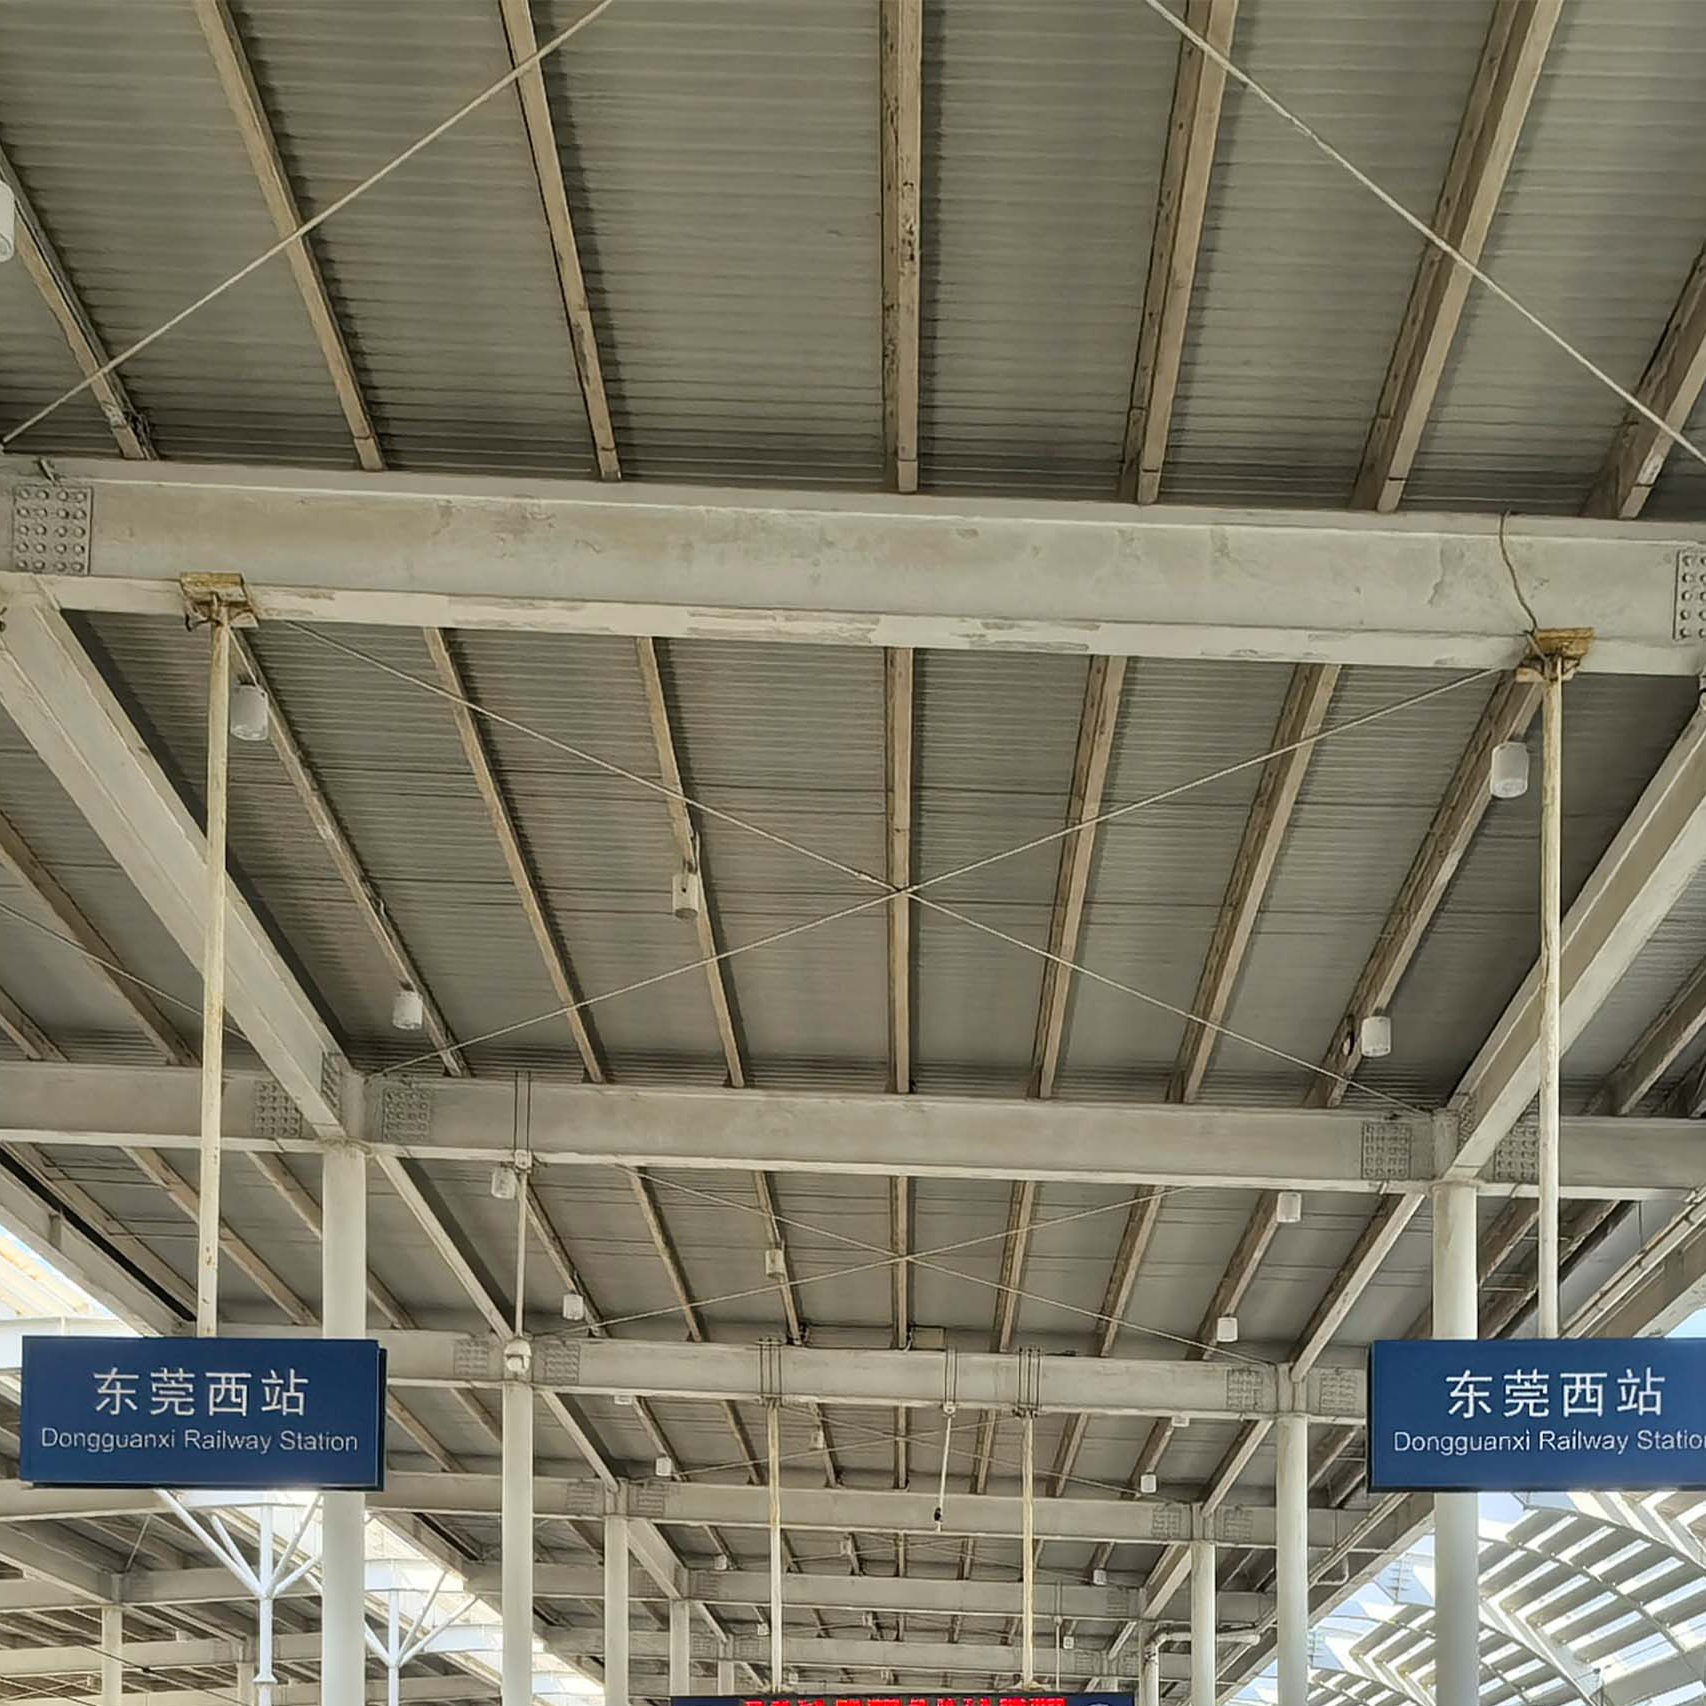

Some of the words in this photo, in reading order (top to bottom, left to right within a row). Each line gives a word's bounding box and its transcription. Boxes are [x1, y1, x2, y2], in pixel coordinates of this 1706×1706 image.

[93, 1367, 309, 1417] 东莞西站
[1445, 1367, 1666, 1418] 东莞西站
[41, 1427, 176, 1453] Dongguanxi
[184, 1429, 272, 1455] Railway
[279, 1430, 358, 1451] Station
[1394, 1429, 1531, 1456] Dongguanxi
[1539, 1429, 1630, 1455] Railway
